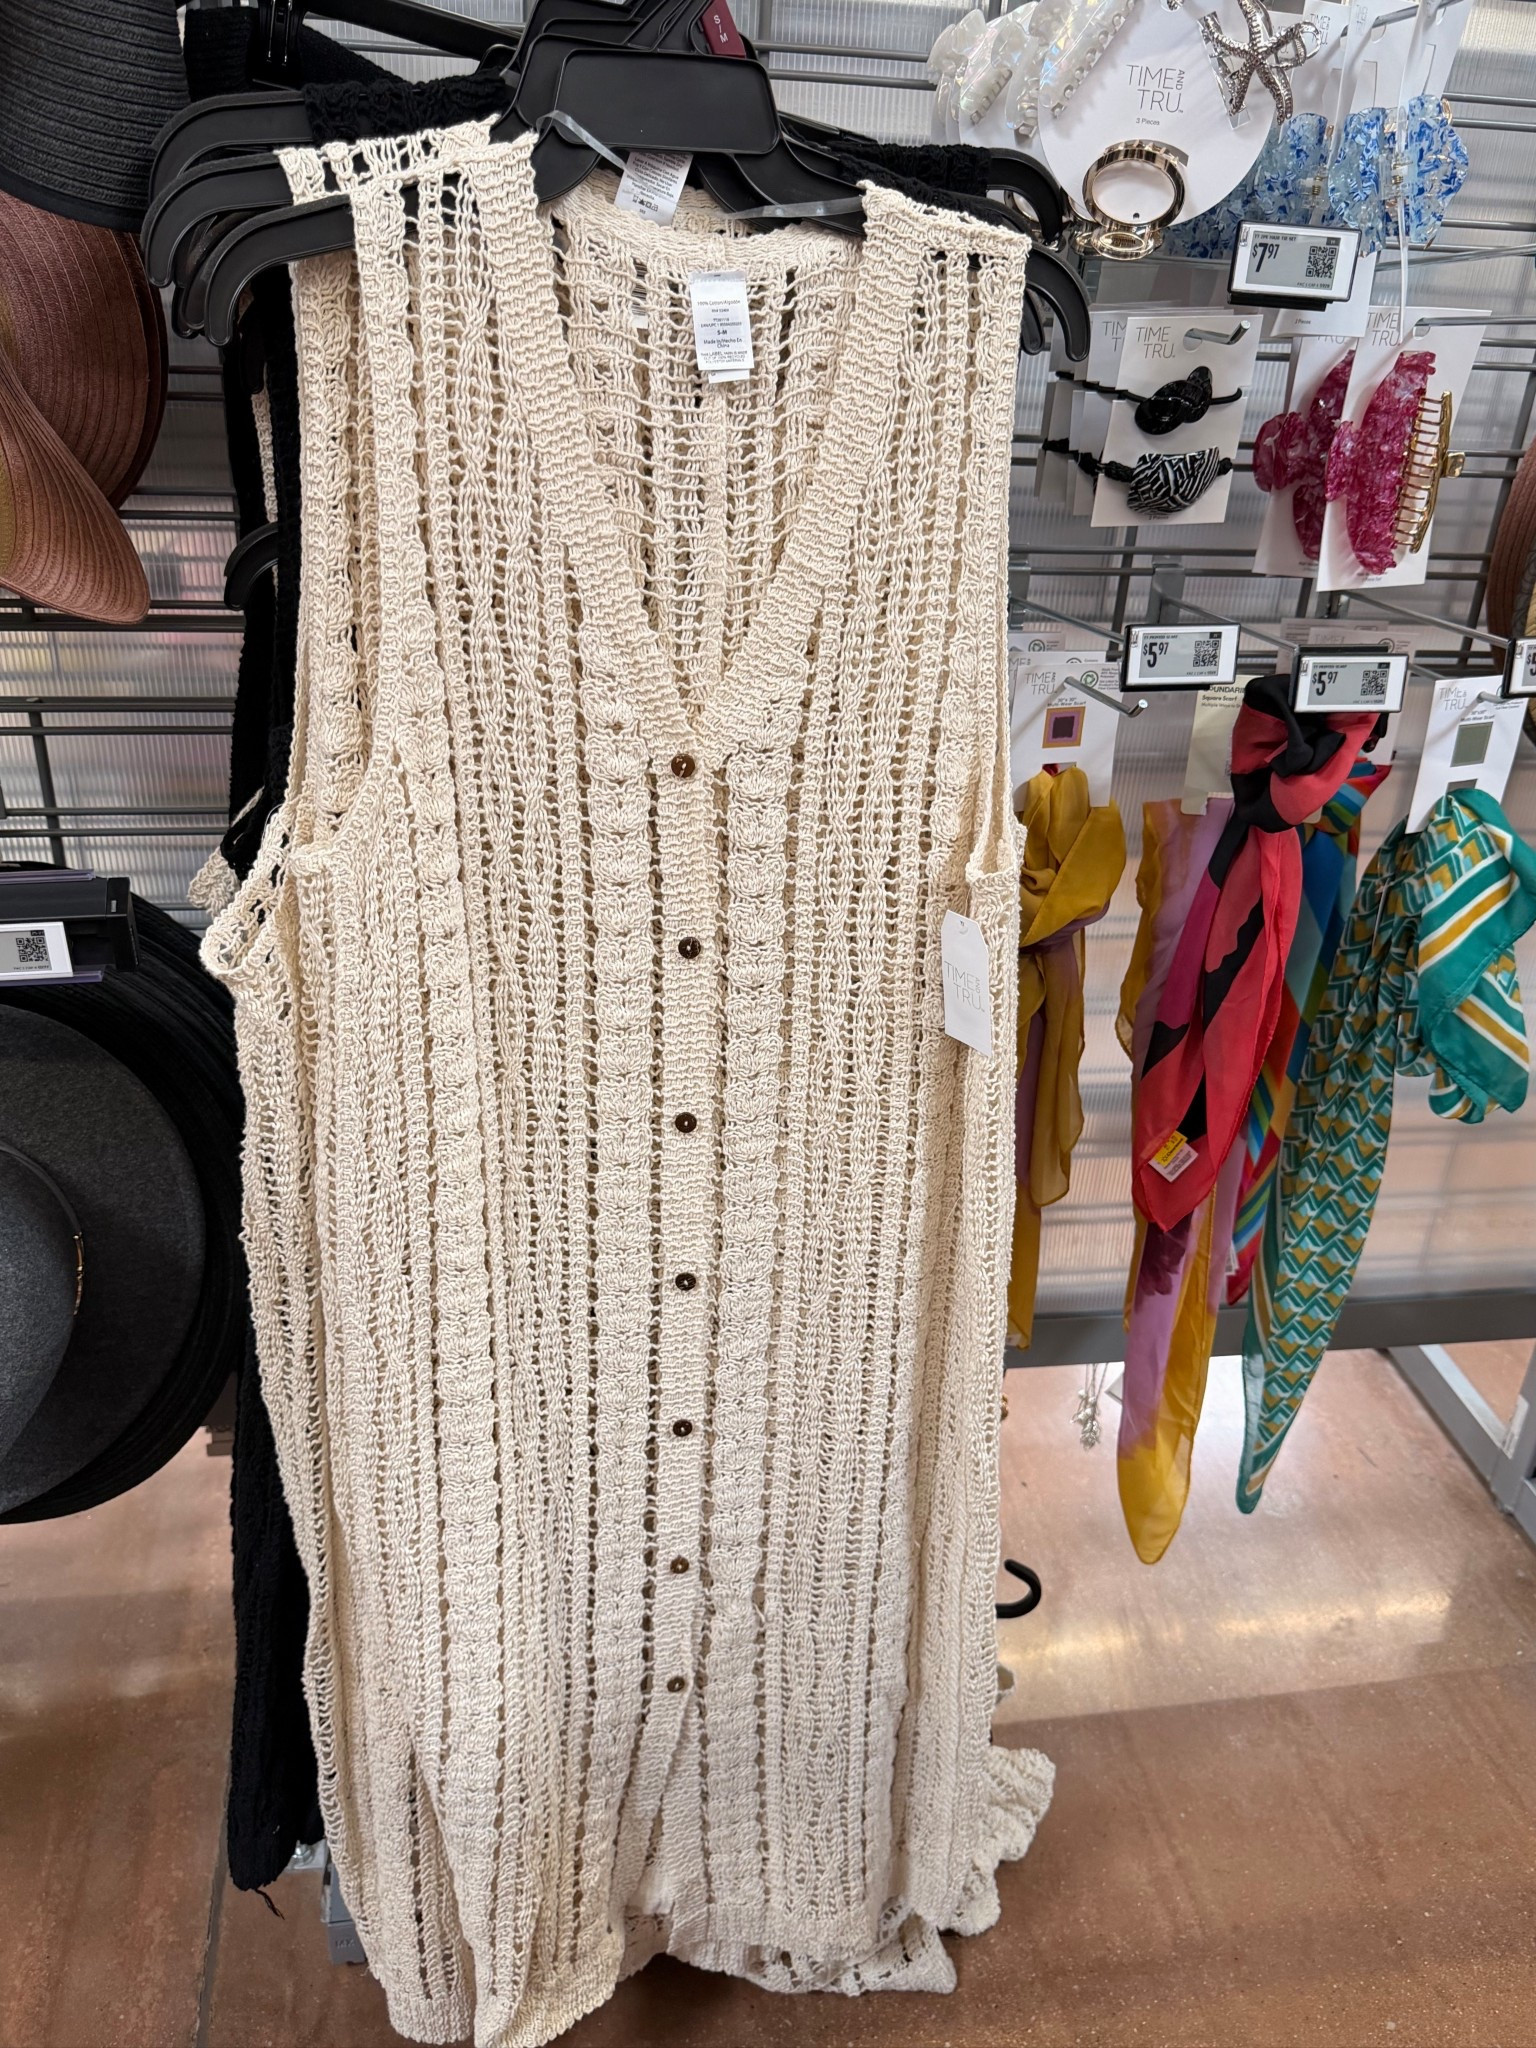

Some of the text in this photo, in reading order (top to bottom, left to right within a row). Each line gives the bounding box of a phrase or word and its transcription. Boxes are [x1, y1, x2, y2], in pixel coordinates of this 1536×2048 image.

[1126, 64, 1177, 90] TIME
[1175, 69, 1185, 91] AND
[1137, 89, 1182, 113] TRU
[1141, 118, 1160, 126] Pieces
[1103, 321, 1127, 336] TIM
[1367, 311, 1400, 329] TIME
[1136, 326, 1171, 342] TIME
[1025, 672, 1051, 684] TIME
[1032, 684, 1057, 695] TRU
[1440, 688, 1462, 699] TIME
[944, 961, 975, 992] TIME
[954, 982, 985, 1012] TRU
